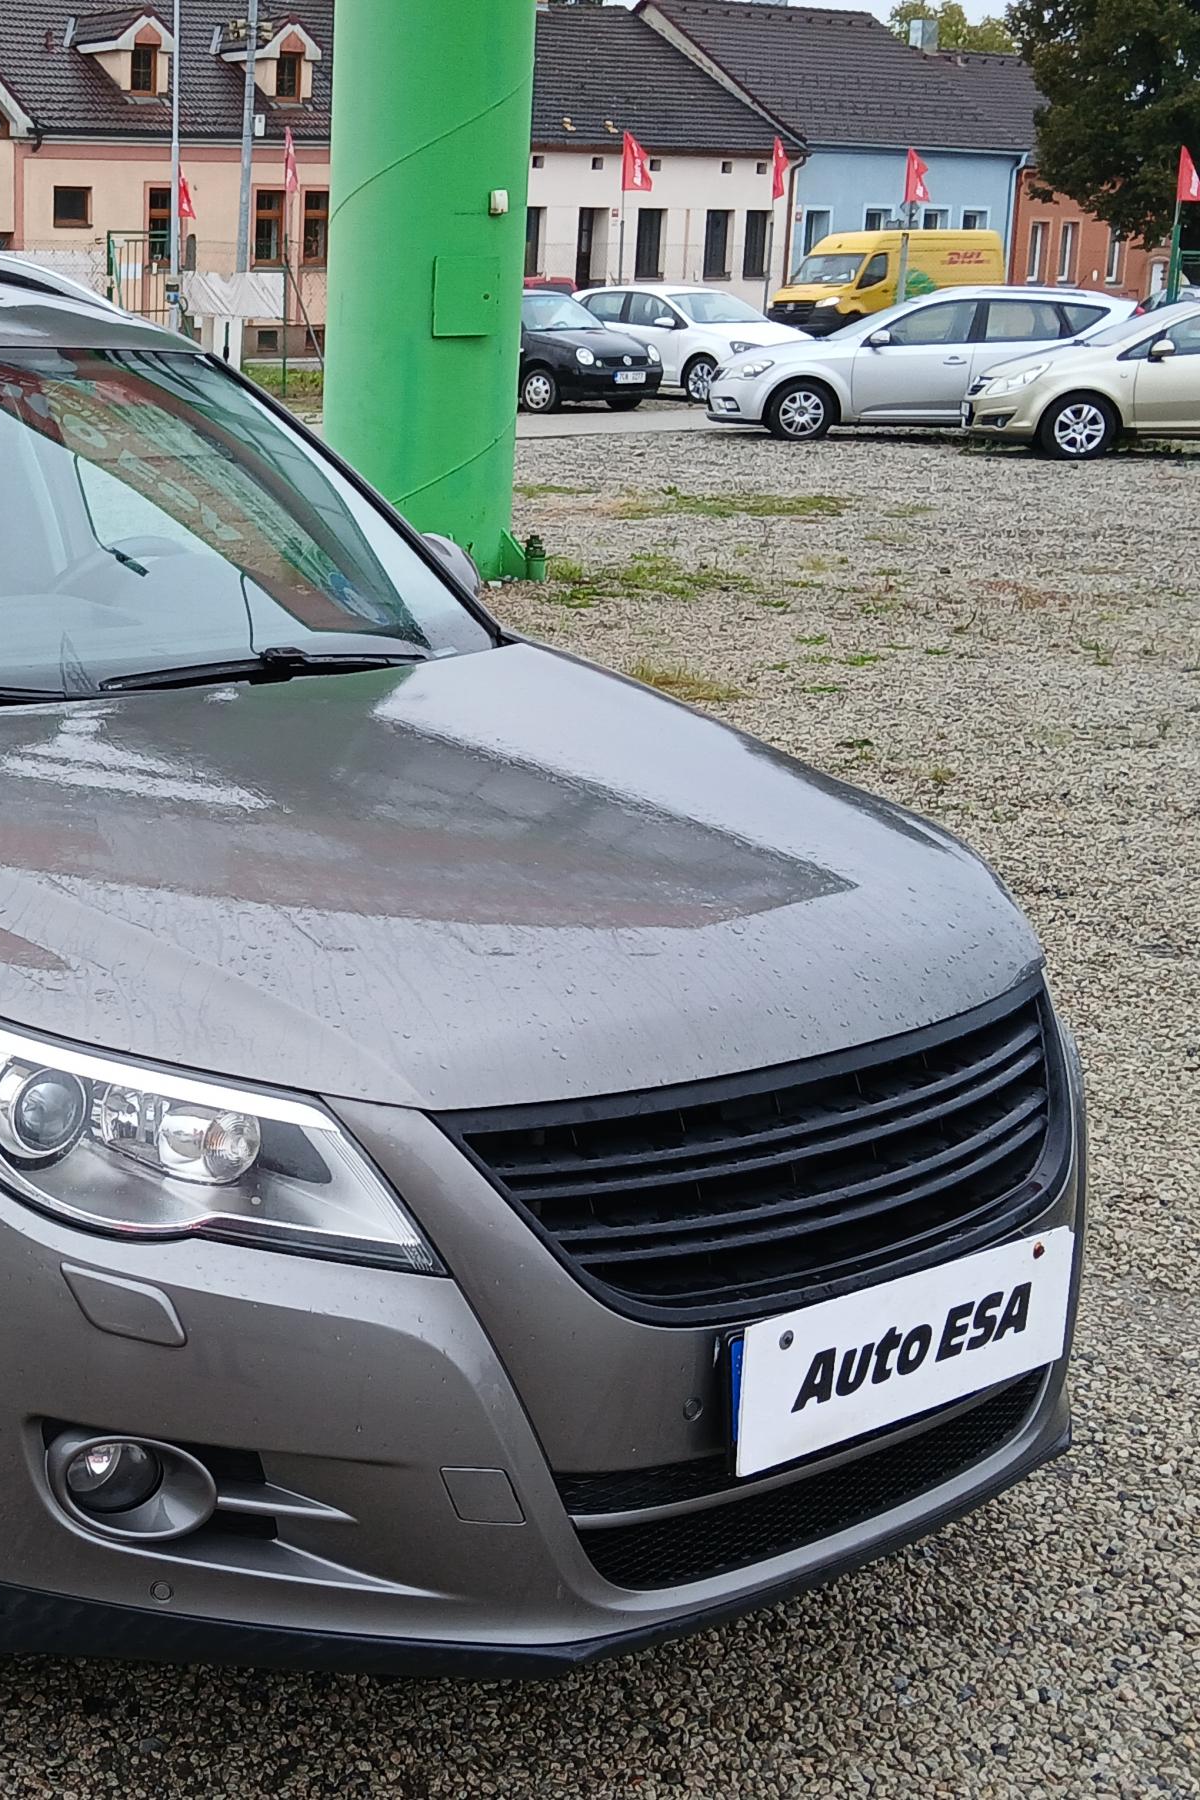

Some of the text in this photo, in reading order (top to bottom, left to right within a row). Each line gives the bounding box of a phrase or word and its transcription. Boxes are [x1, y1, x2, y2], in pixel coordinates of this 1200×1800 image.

[947, 251, 984, 264] DHL
[791, 1282, 1032, 1413] Auto ESA
